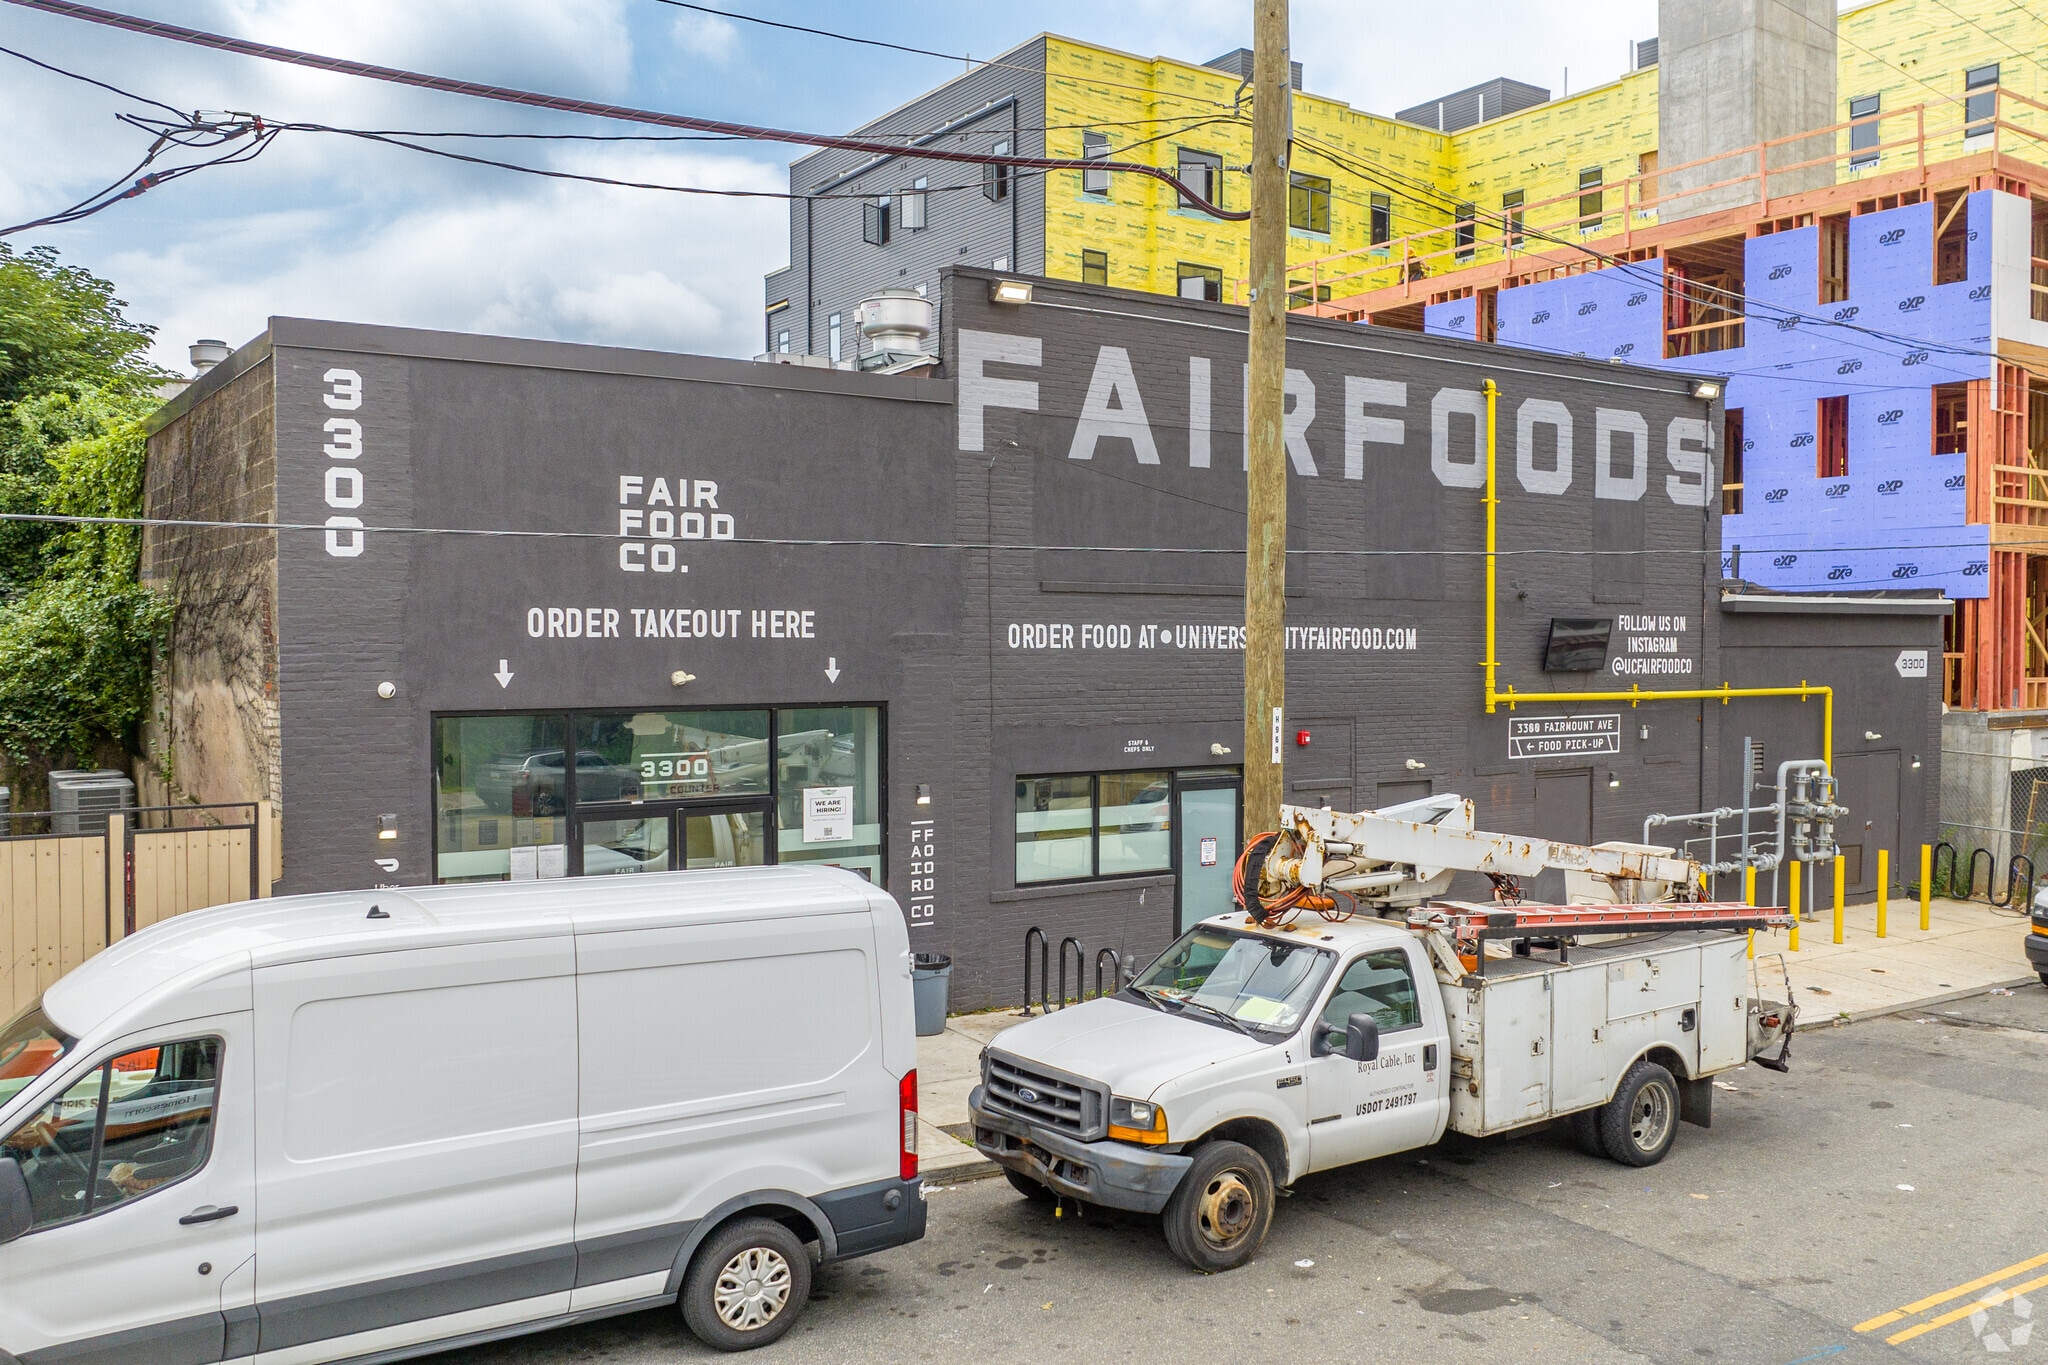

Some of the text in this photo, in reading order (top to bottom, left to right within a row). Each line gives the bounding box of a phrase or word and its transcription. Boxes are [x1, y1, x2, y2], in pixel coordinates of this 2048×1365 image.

[323, 368, 364, 557] 3300
[619, 475, 719, 508] FAIR
[619, 508, 735, 539] FOOD
[619, 543, 689, 573] CO.
[527, 607, 816, 639] ORDER TAKEOUT HERE
[1618, 615, 1686, 632] FOLLOW US ON
[1008, 623, 1074, 649] ORDER
[1081, 624, 1131, 649] FOOD
[1138, 624, 1158, 649] AT
[1627, 636, 1678, 653] INSTAGRAM
[1611, 657, 1692, 676] @UCFAIRFOODCO
[1902, 658, 1924, 669] 3300
[1544, 720, 1594, 732] FAIRMOUNT
[1597, 719, 1613, 731] AVE
[1538, 738, 1604, 752] FOOD PICK-UP
[641, 759, 708, 777] 3300
[615, 867, 635, 875] FAIR
[1285, 1050, 1291, 1064] 5
[1357, 1052, 1416, 1075] Royal Cable, Inc
[1356, 1092, 1417, 1116] USDOT 2491797
